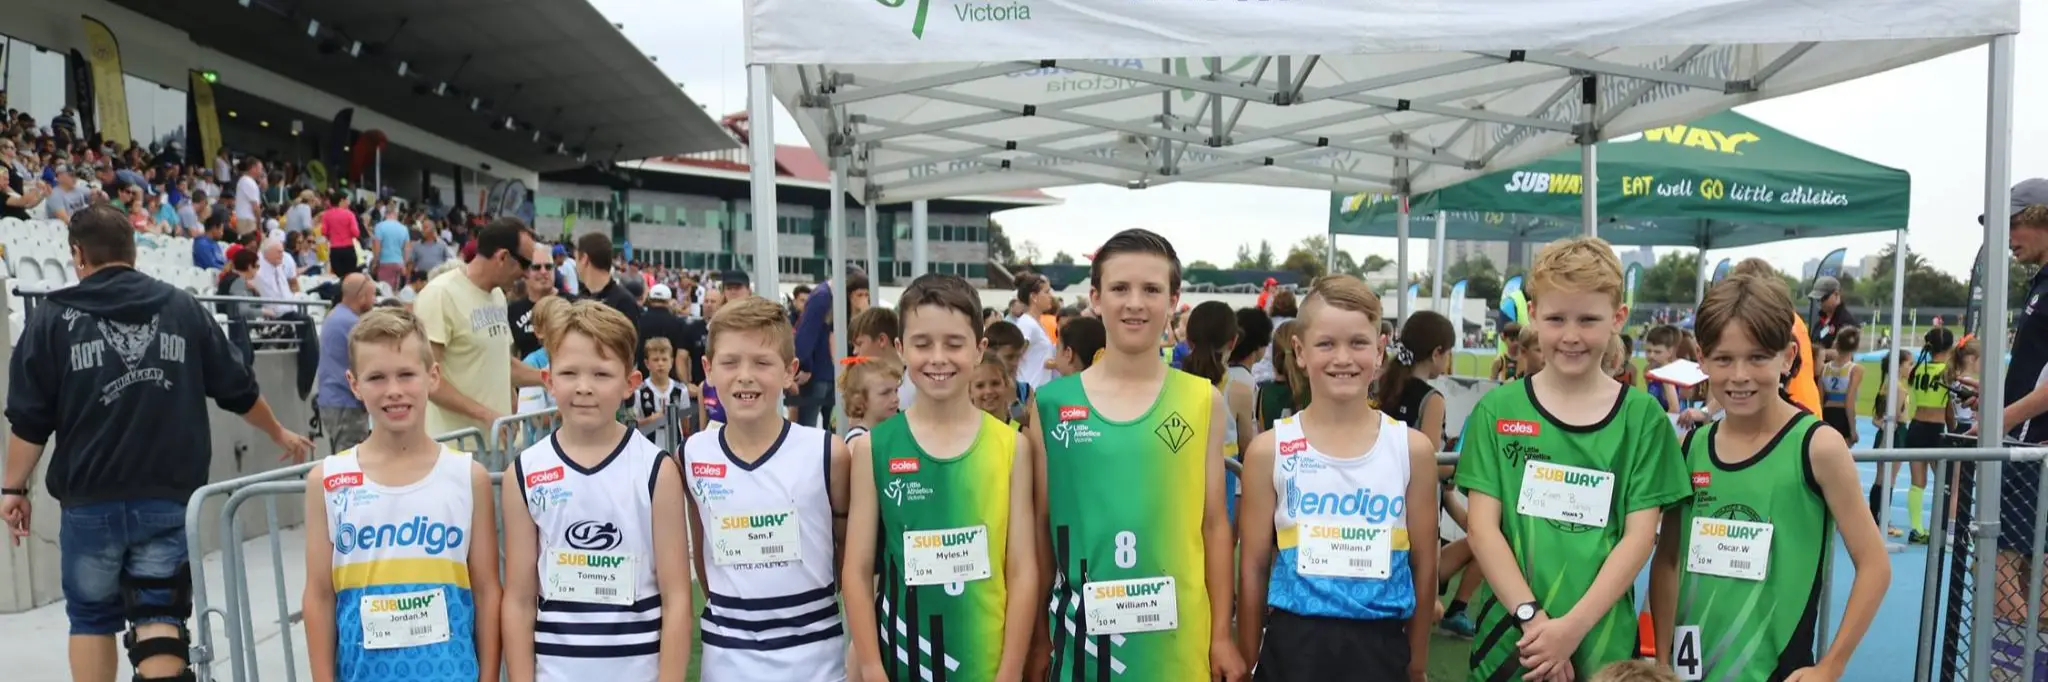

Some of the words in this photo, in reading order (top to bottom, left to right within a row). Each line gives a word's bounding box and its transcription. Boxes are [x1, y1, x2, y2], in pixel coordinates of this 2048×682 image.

[954, 2, 1031, 22] Victoria
[1505, 171, 1584, 194] SUBWA
[1622, 175, 1654, 196] EAT
[1657, 180, 1693, 198] well
[1700, 178, 1724, 200] GO
[1730, 182, 1774, 204] little
[1780, 186, 1849, 206] athletics
[71, 339, 105, 371] HOT
[159, 332, 186, 364] ROD
[1831, 377, 1840, 389] 2
[1060, 409, 1086, 417] coles
[1172, 418, 1180, 427] D
[1502, 422, 1533, 433] coles
[694, 465, 721, 476] coles
[891, 461, 917, 469] coles
[328, 474, 358, 487] coles
[530, 470, 560, 483] coles
[1534, 467, 1605, 488] SUBWAY
[1286, 477, 1405, 524] bendigo
[721, 513, 788, 529] SUBWAY
[335, 515, 463, 555] bendigo
[748, 532, 774, 540] Sam.F
[913, 530, 979, 548] SUBWAY
[1310, 525, 1382, 541] SUBWAY
[1699, 523, 1763, 540] SUBWAY
[936, 550, 969, 560] Myles.H
[1115, 530, 1137, 569] 8
[1331, 543, 1371, 553] William.P
[1718, 542, 1749, 554] Oscar.W
[557, 552, 625, 568] SUBWAY
[578, 572, 616, 581] Tommy.S
[1095, 582, 1165, 599] SUBWAY
[370, 595, 434, 612] SUBWAY
[1116, 600, 1157, 609] William.N
[390, 611, 428, 622] Jordan.M
[1677, 631, 1699, 675] 4
